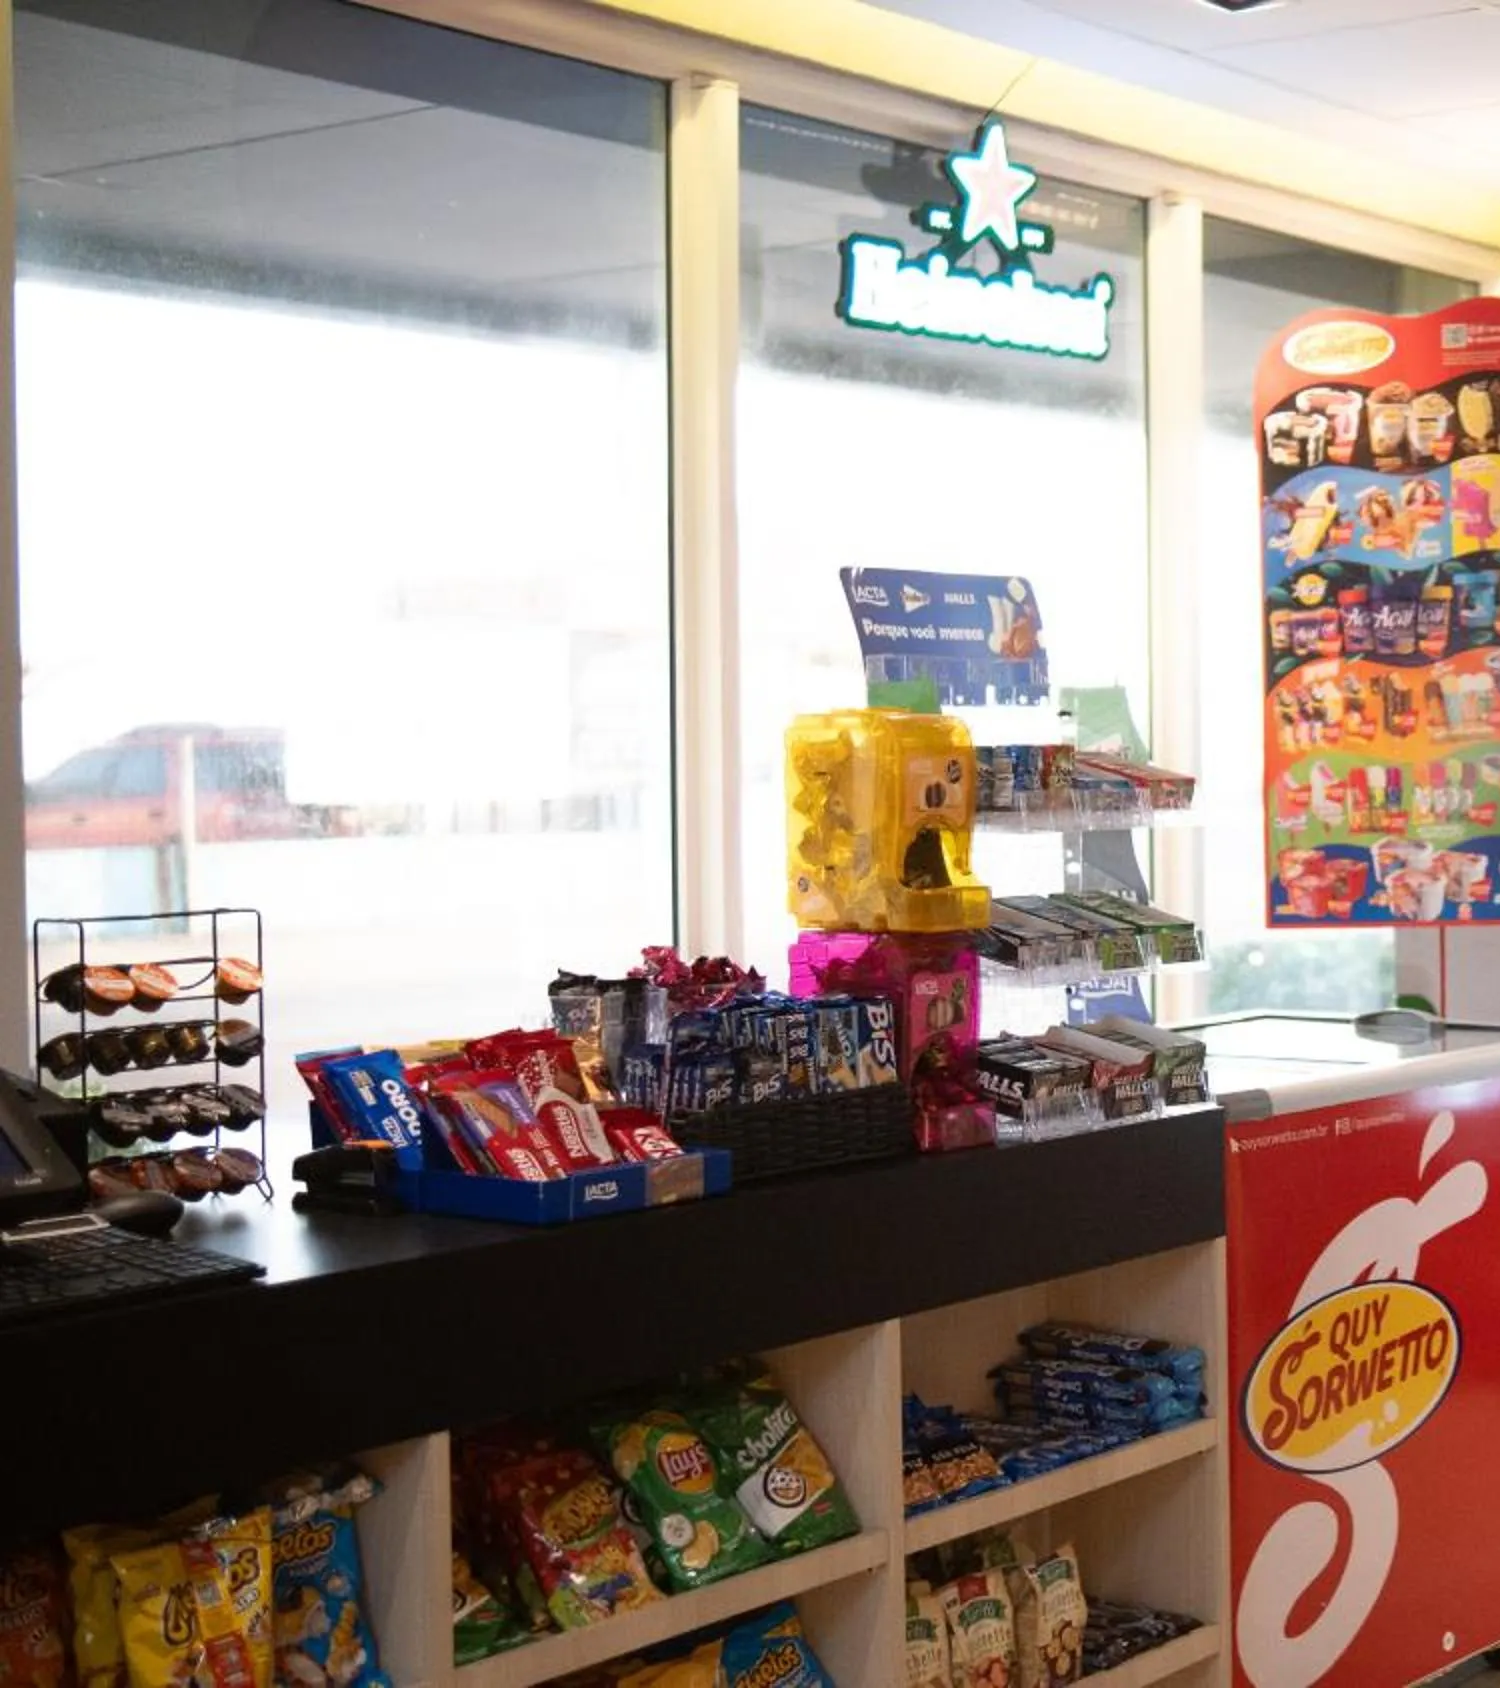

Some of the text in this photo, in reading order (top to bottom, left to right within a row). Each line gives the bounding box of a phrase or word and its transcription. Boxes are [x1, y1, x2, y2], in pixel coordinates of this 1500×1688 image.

[862, 617, 908, 641] Porque
[977, 1070, 1025, 1099] ALLS
[1329, 1294, 1391, 1360] QUY
[1262, 1317, 1449, 1452] SORWETTO
